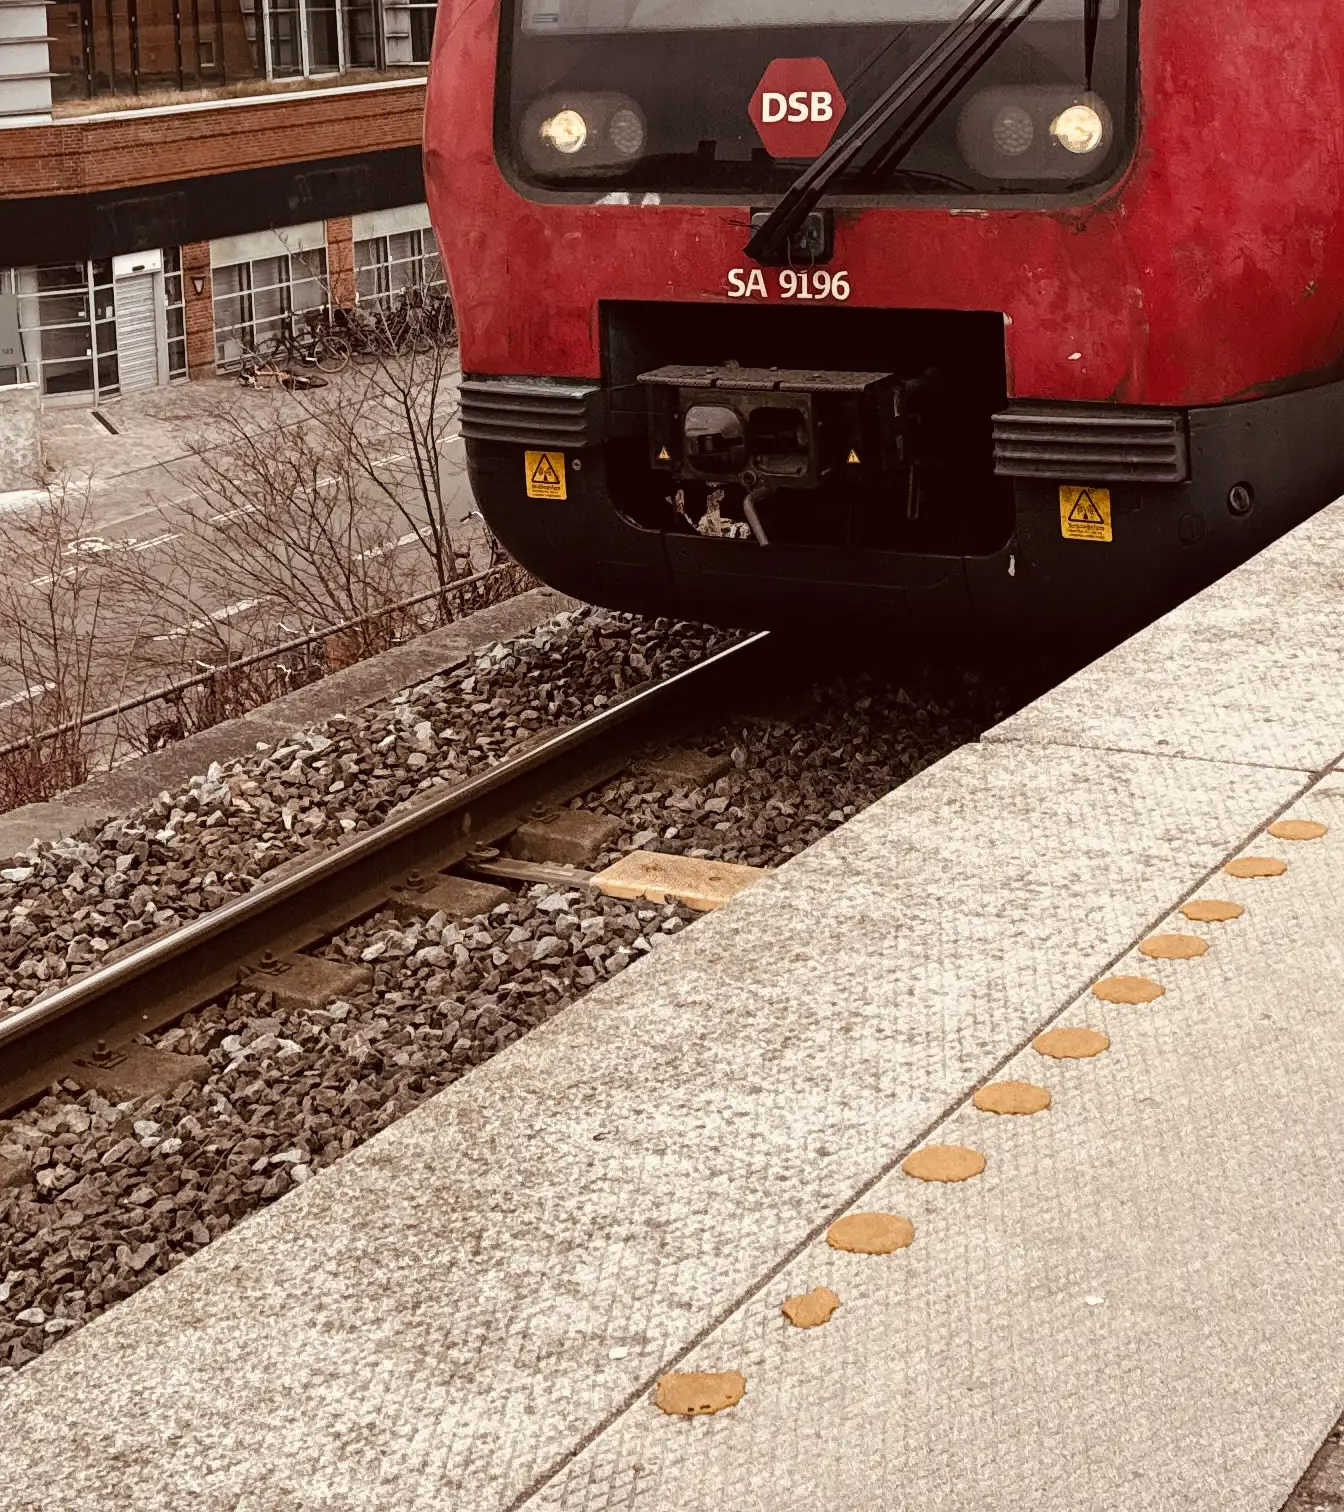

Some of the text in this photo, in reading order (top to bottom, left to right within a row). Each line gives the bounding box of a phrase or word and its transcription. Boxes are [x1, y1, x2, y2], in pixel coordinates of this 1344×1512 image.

[762, 91, 833, 123] DSB
[727, 268, 851, 300] SA 9196
